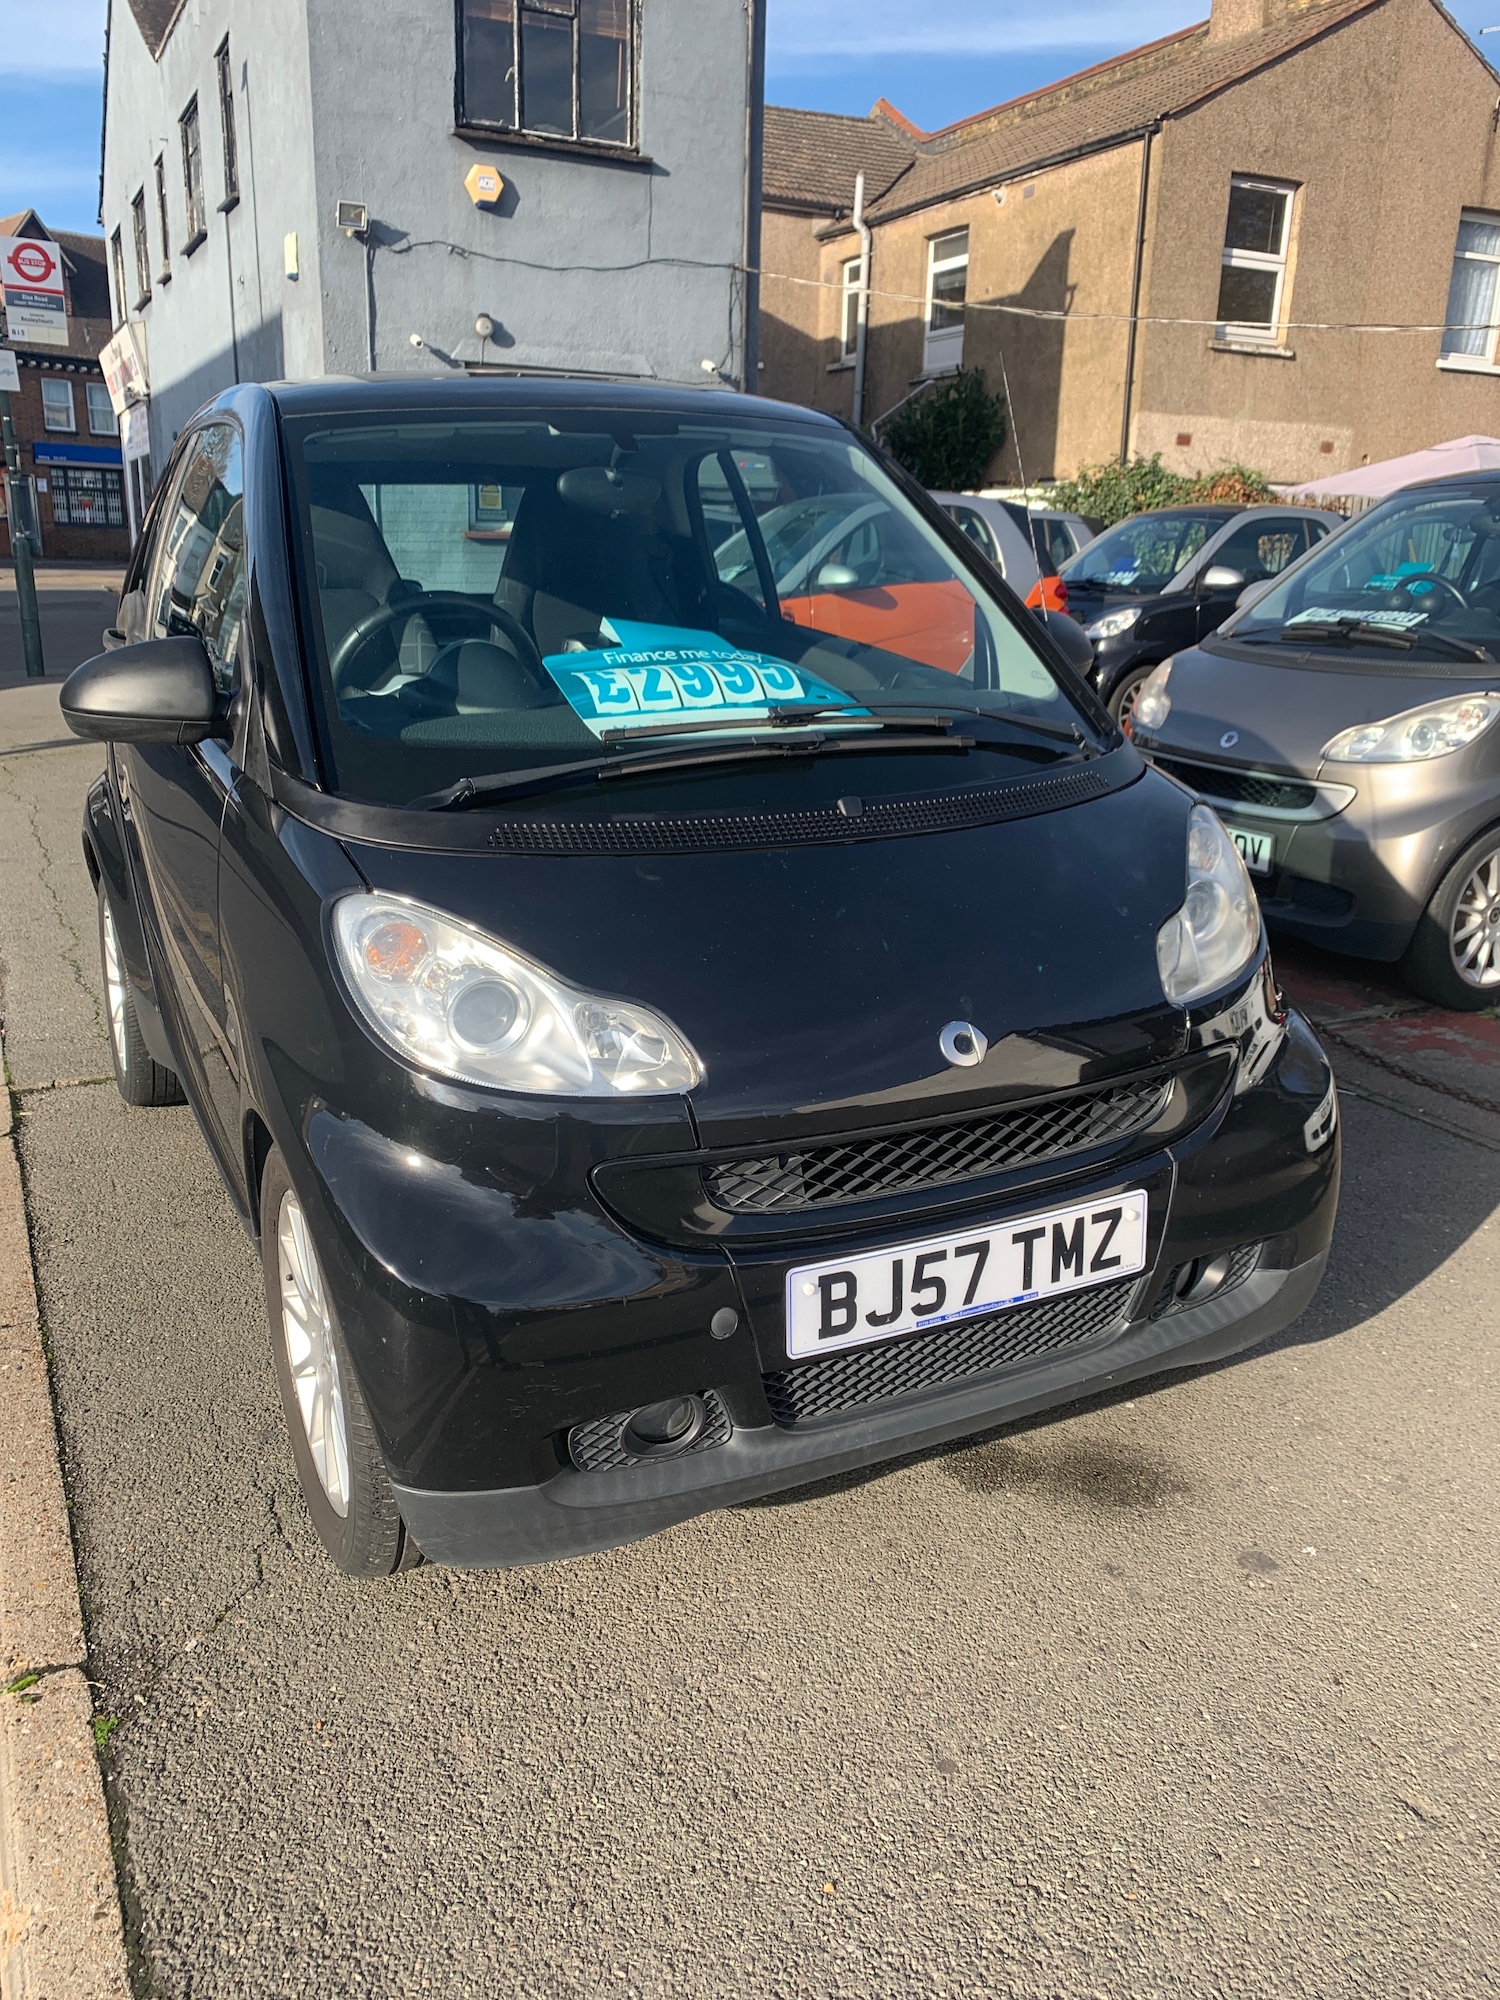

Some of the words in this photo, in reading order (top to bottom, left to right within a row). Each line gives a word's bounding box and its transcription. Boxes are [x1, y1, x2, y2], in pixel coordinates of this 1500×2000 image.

[478, 176, 496, 190] ADT
[18, 257, 30, 265] BUS
[31, 259, 47, 267] STOP
[34, 294, 48, 302] Road
[602, 650, 678, 665] Finance
[680, 650, 710, 659] me
[712, 649, 764, 664] today
[582, 661, 796, 706] £2995
[818, 1239, 991, 1341] BJ57
[1012, 1207, 1124, 1291] TMZ
